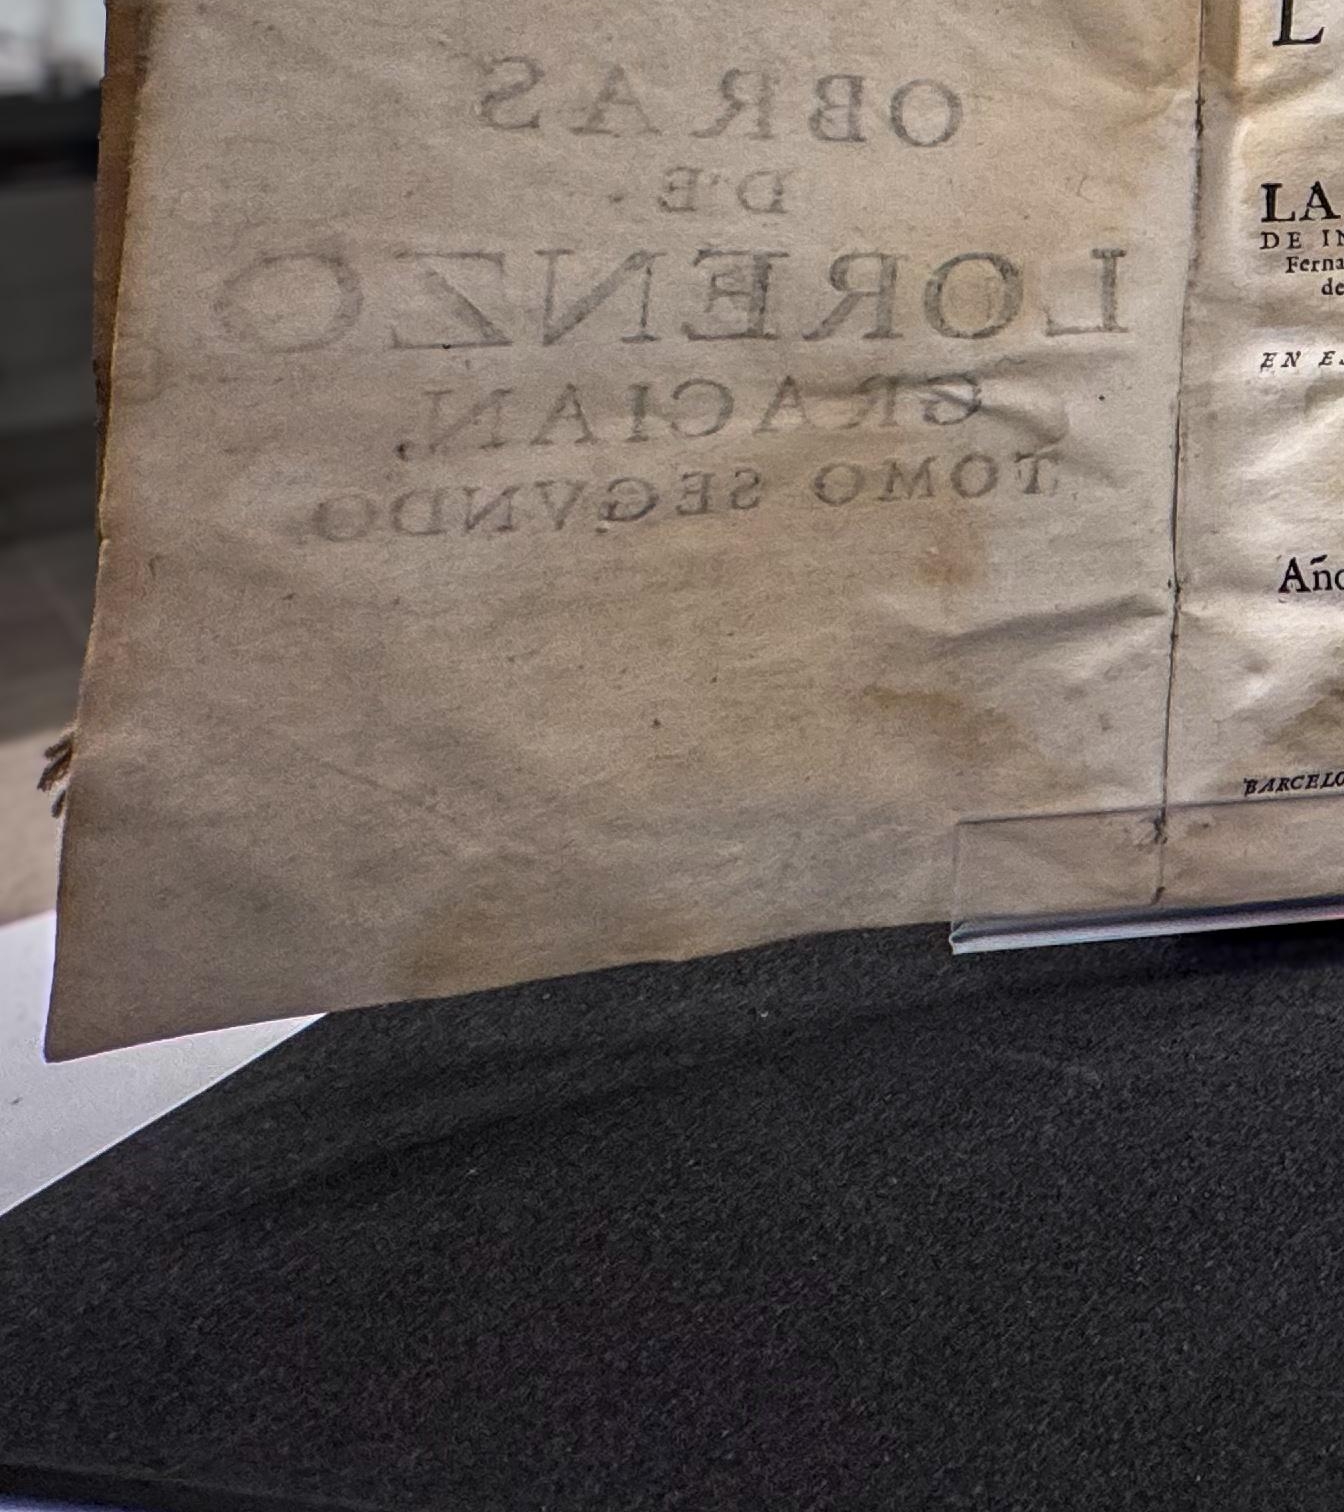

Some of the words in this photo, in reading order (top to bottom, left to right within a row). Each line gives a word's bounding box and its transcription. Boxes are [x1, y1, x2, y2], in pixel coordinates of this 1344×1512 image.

[1261, 180, 1342, 224] LA
[1260, 231, 1302, 250] DE
[1259, 350, 1302, 369] EN
